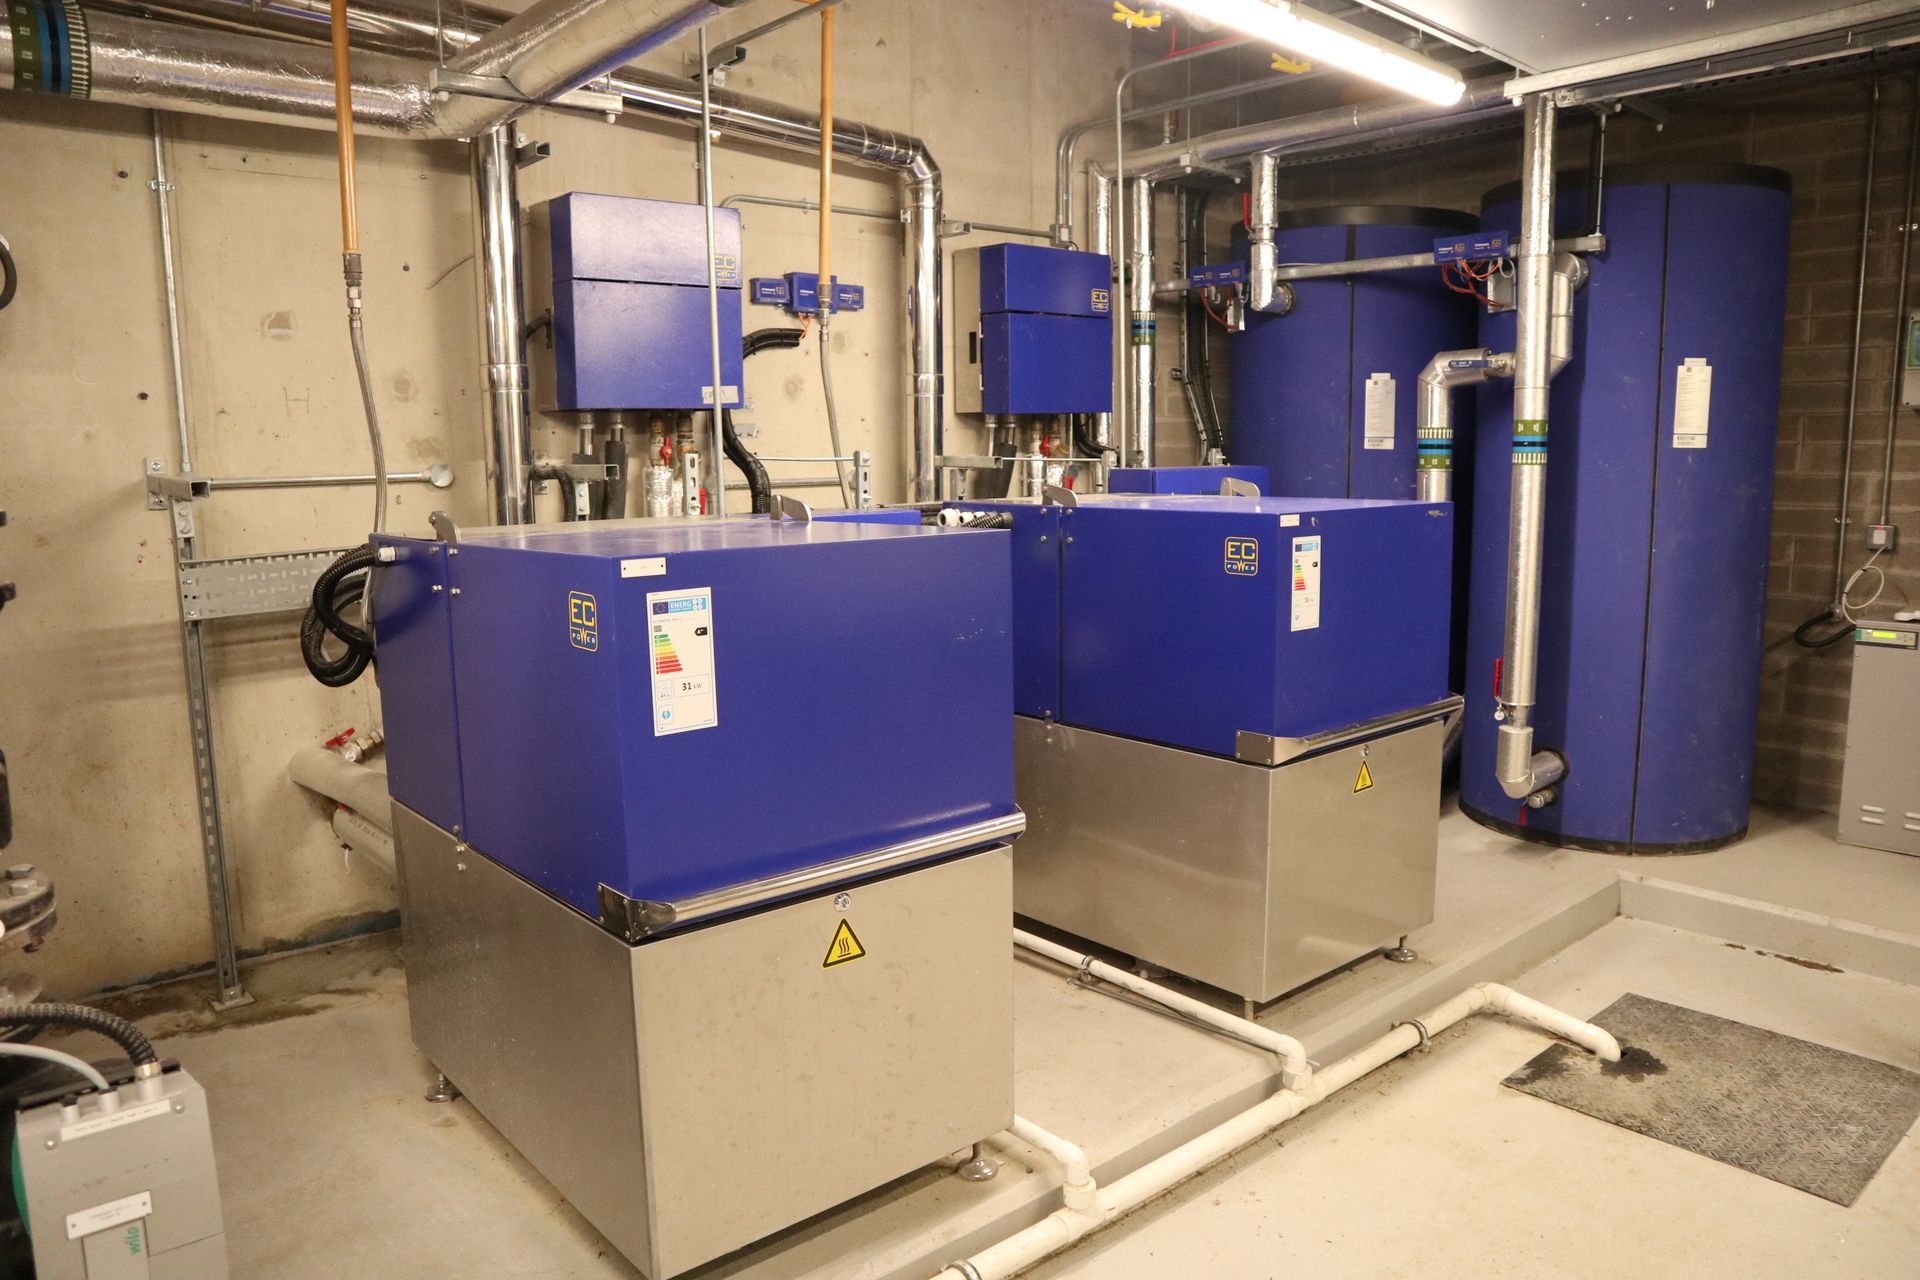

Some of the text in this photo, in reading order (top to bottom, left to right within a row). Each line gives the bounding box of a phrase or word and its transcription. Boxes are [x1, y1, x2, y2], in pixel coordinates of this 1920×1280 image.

[1093, 291, 1107, 303] EC
[1227, 541, 1255, 559] EC
[1227, 560, 1255, 572] POWER
[571, 599, 595, 626] EC
[572, 628, 596, 645] POWER
[681, 682, 692, 691] 31
[125, 1226, 142, 1255] wilo
